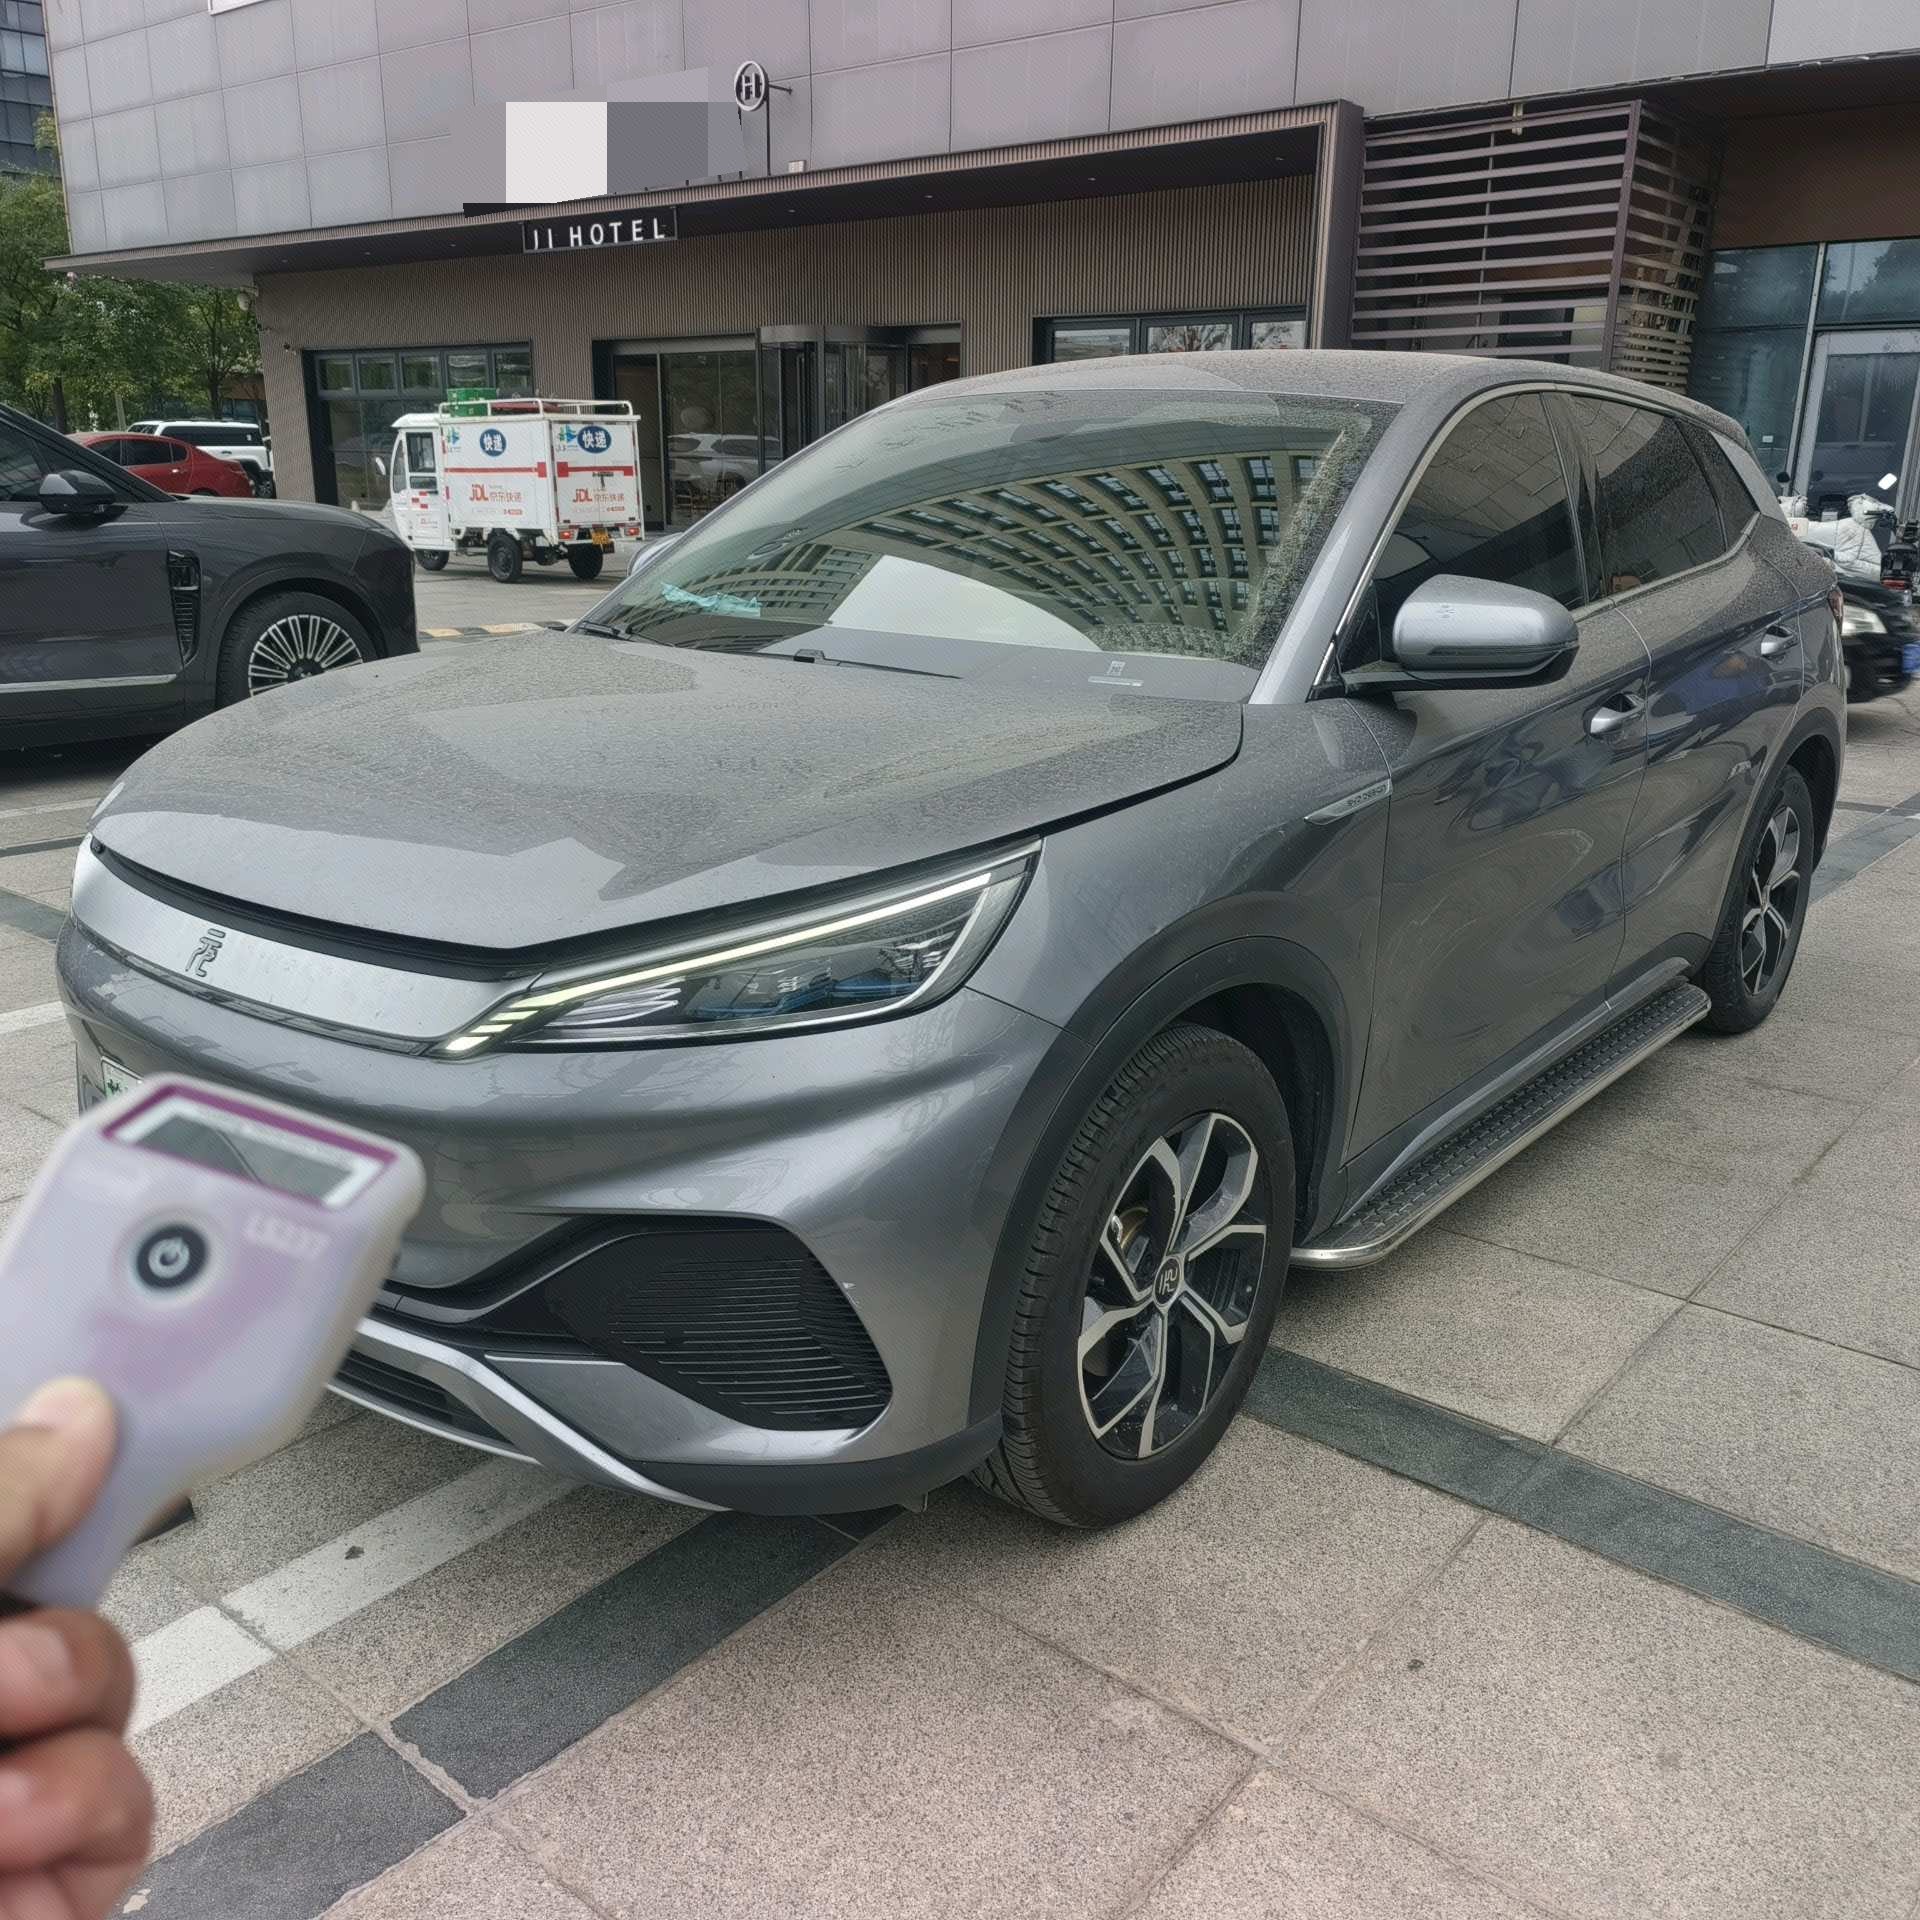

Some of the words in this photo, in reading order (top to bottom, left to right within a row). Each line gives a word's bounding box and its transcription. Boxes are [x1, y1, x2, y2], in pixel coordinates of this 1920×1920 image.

[569, 218, 665, 247] HOTEL
[483, 433, 502, 452] 快递
[582, 429, 607, 448] 快递
